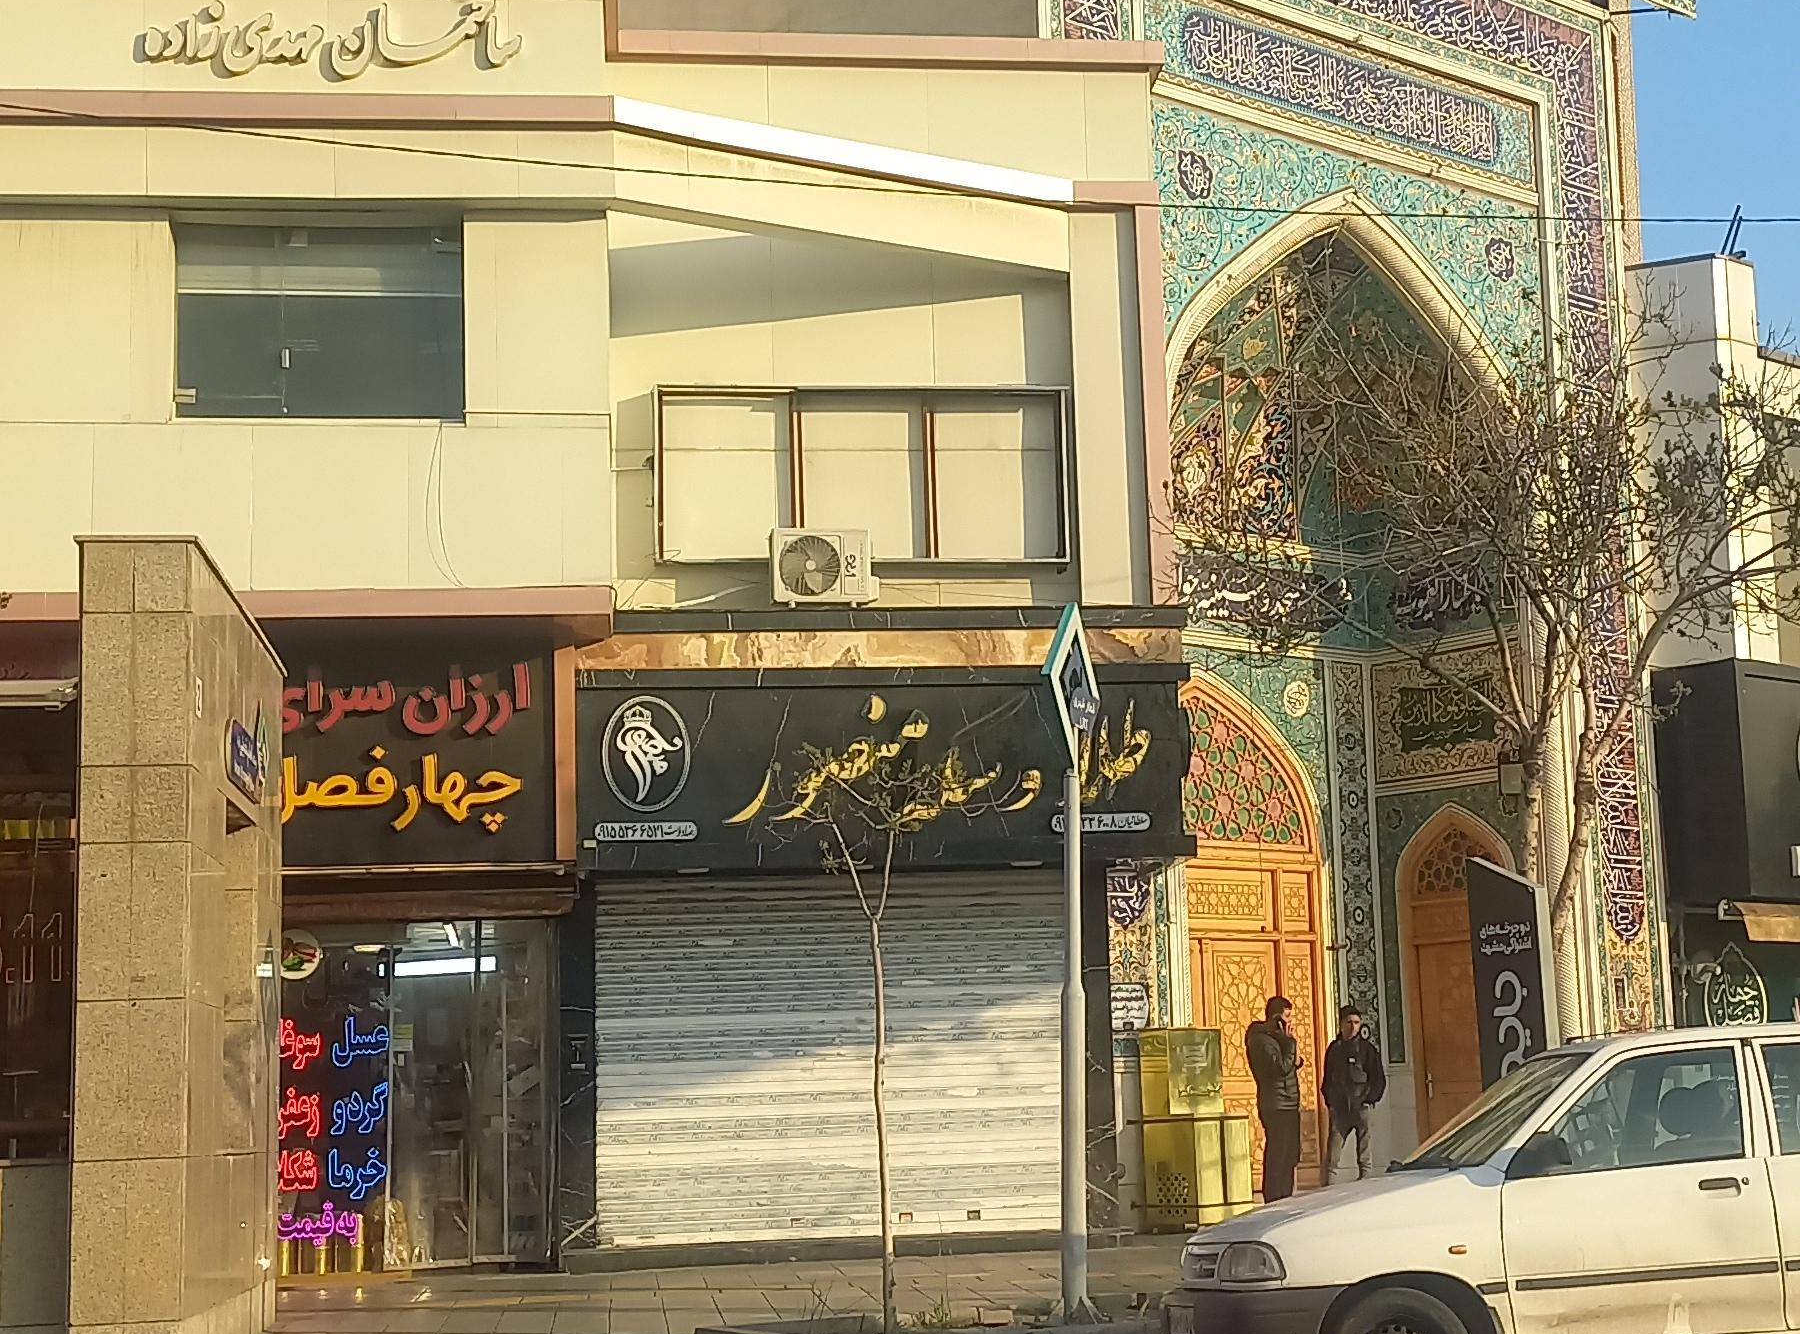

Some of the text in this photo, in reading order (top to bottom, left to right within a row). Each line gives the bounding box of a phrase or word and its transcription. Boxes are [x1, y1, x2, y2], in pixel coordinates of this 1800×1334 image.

[143, 0, 226, 61] زاده
[222, 13, 325, 75] مهدی
[282, 661, 531, 736] ارزان سرای
[389, 752, 524, 834] چهار
[278, 1017, 321, 1071] سوغا
[332, 1015, 391, 1068] عسل
[330, 1081, 389, 1136] گردو
[327, 1147, 388, 1201] خرما
[276, 1201, 360, 1247] به قیمت
